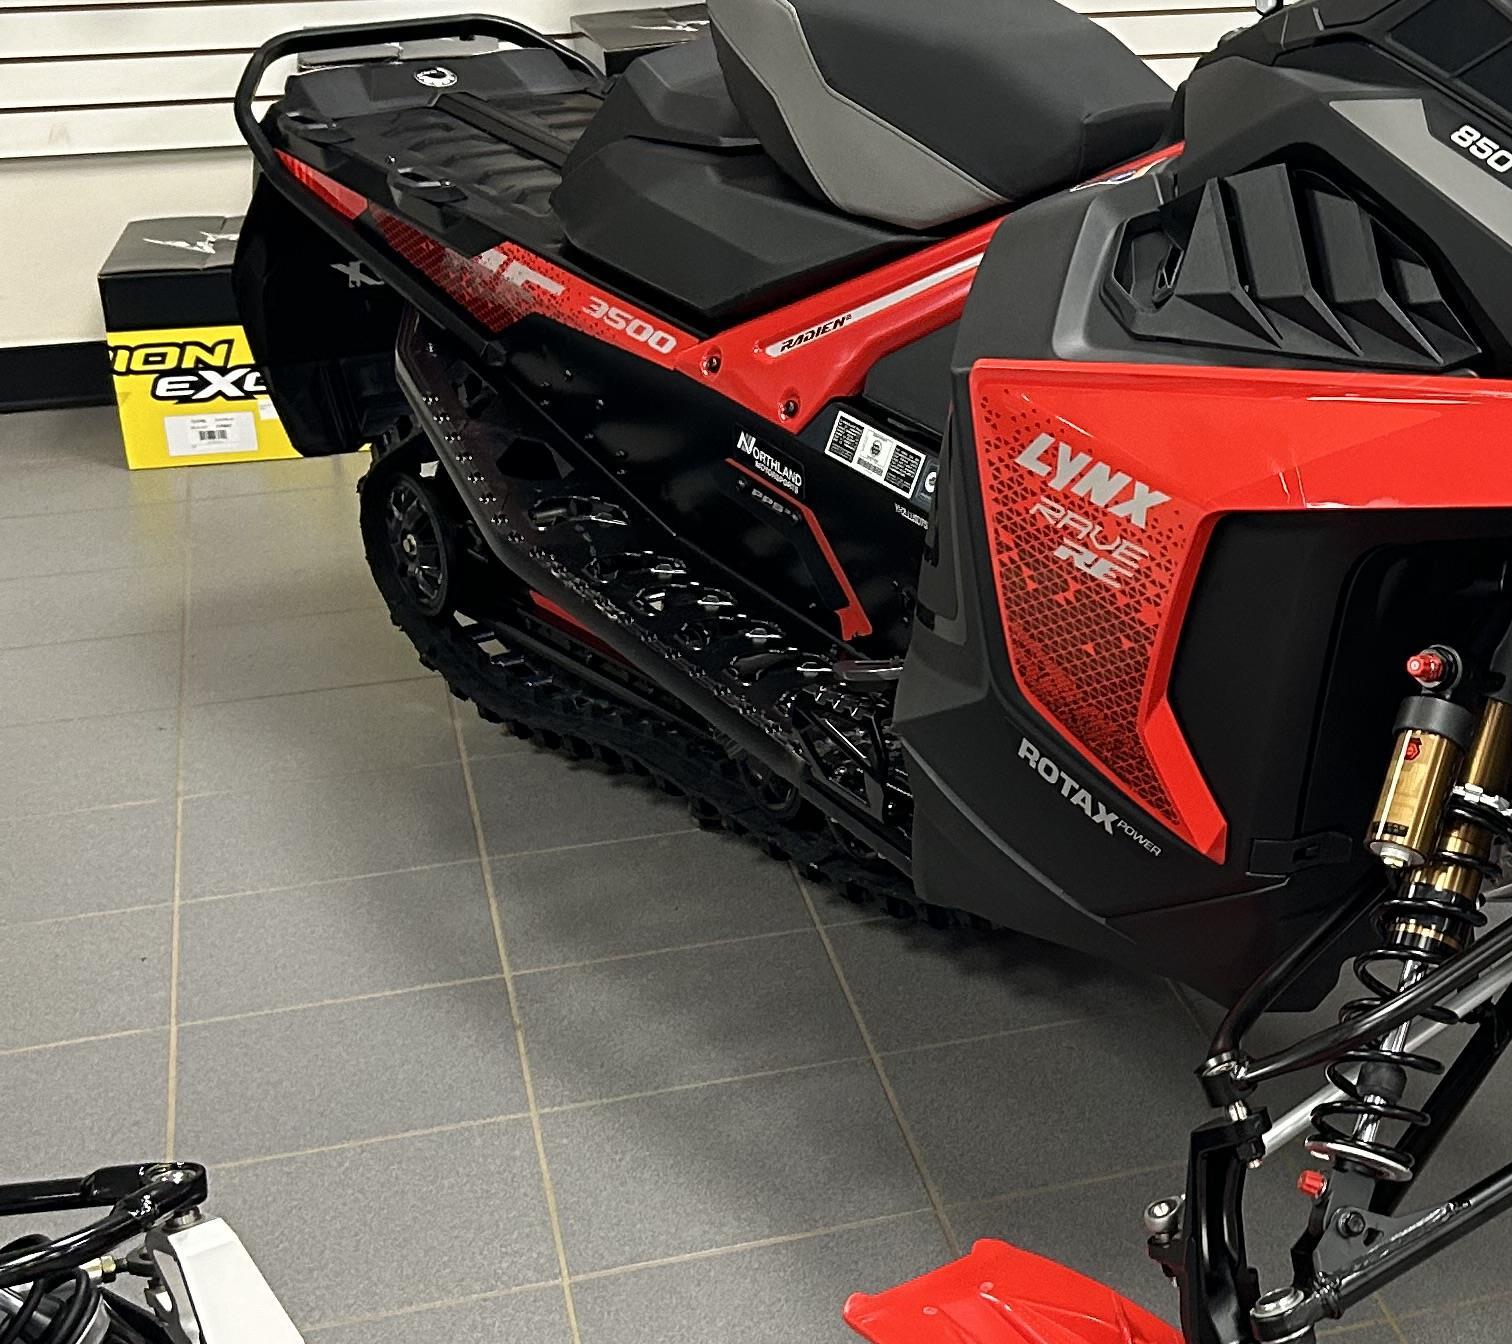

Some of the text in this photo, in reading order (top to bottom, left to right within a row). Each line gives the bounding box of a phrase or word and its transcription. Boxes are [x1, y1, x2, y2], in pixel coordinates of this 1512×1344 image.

[582, 295, 678, 355] 3500
[108, 342, 231, 373] ION
[736, 430, 802, 486] NORTHLAND
[1014, 432, 1173, 529] LYNX
[1029, 495, 1150, 569] RAVE
[1053, 537, 1135, 589] RE
[1018, 737, 1162, 857] ROTAX POWER
